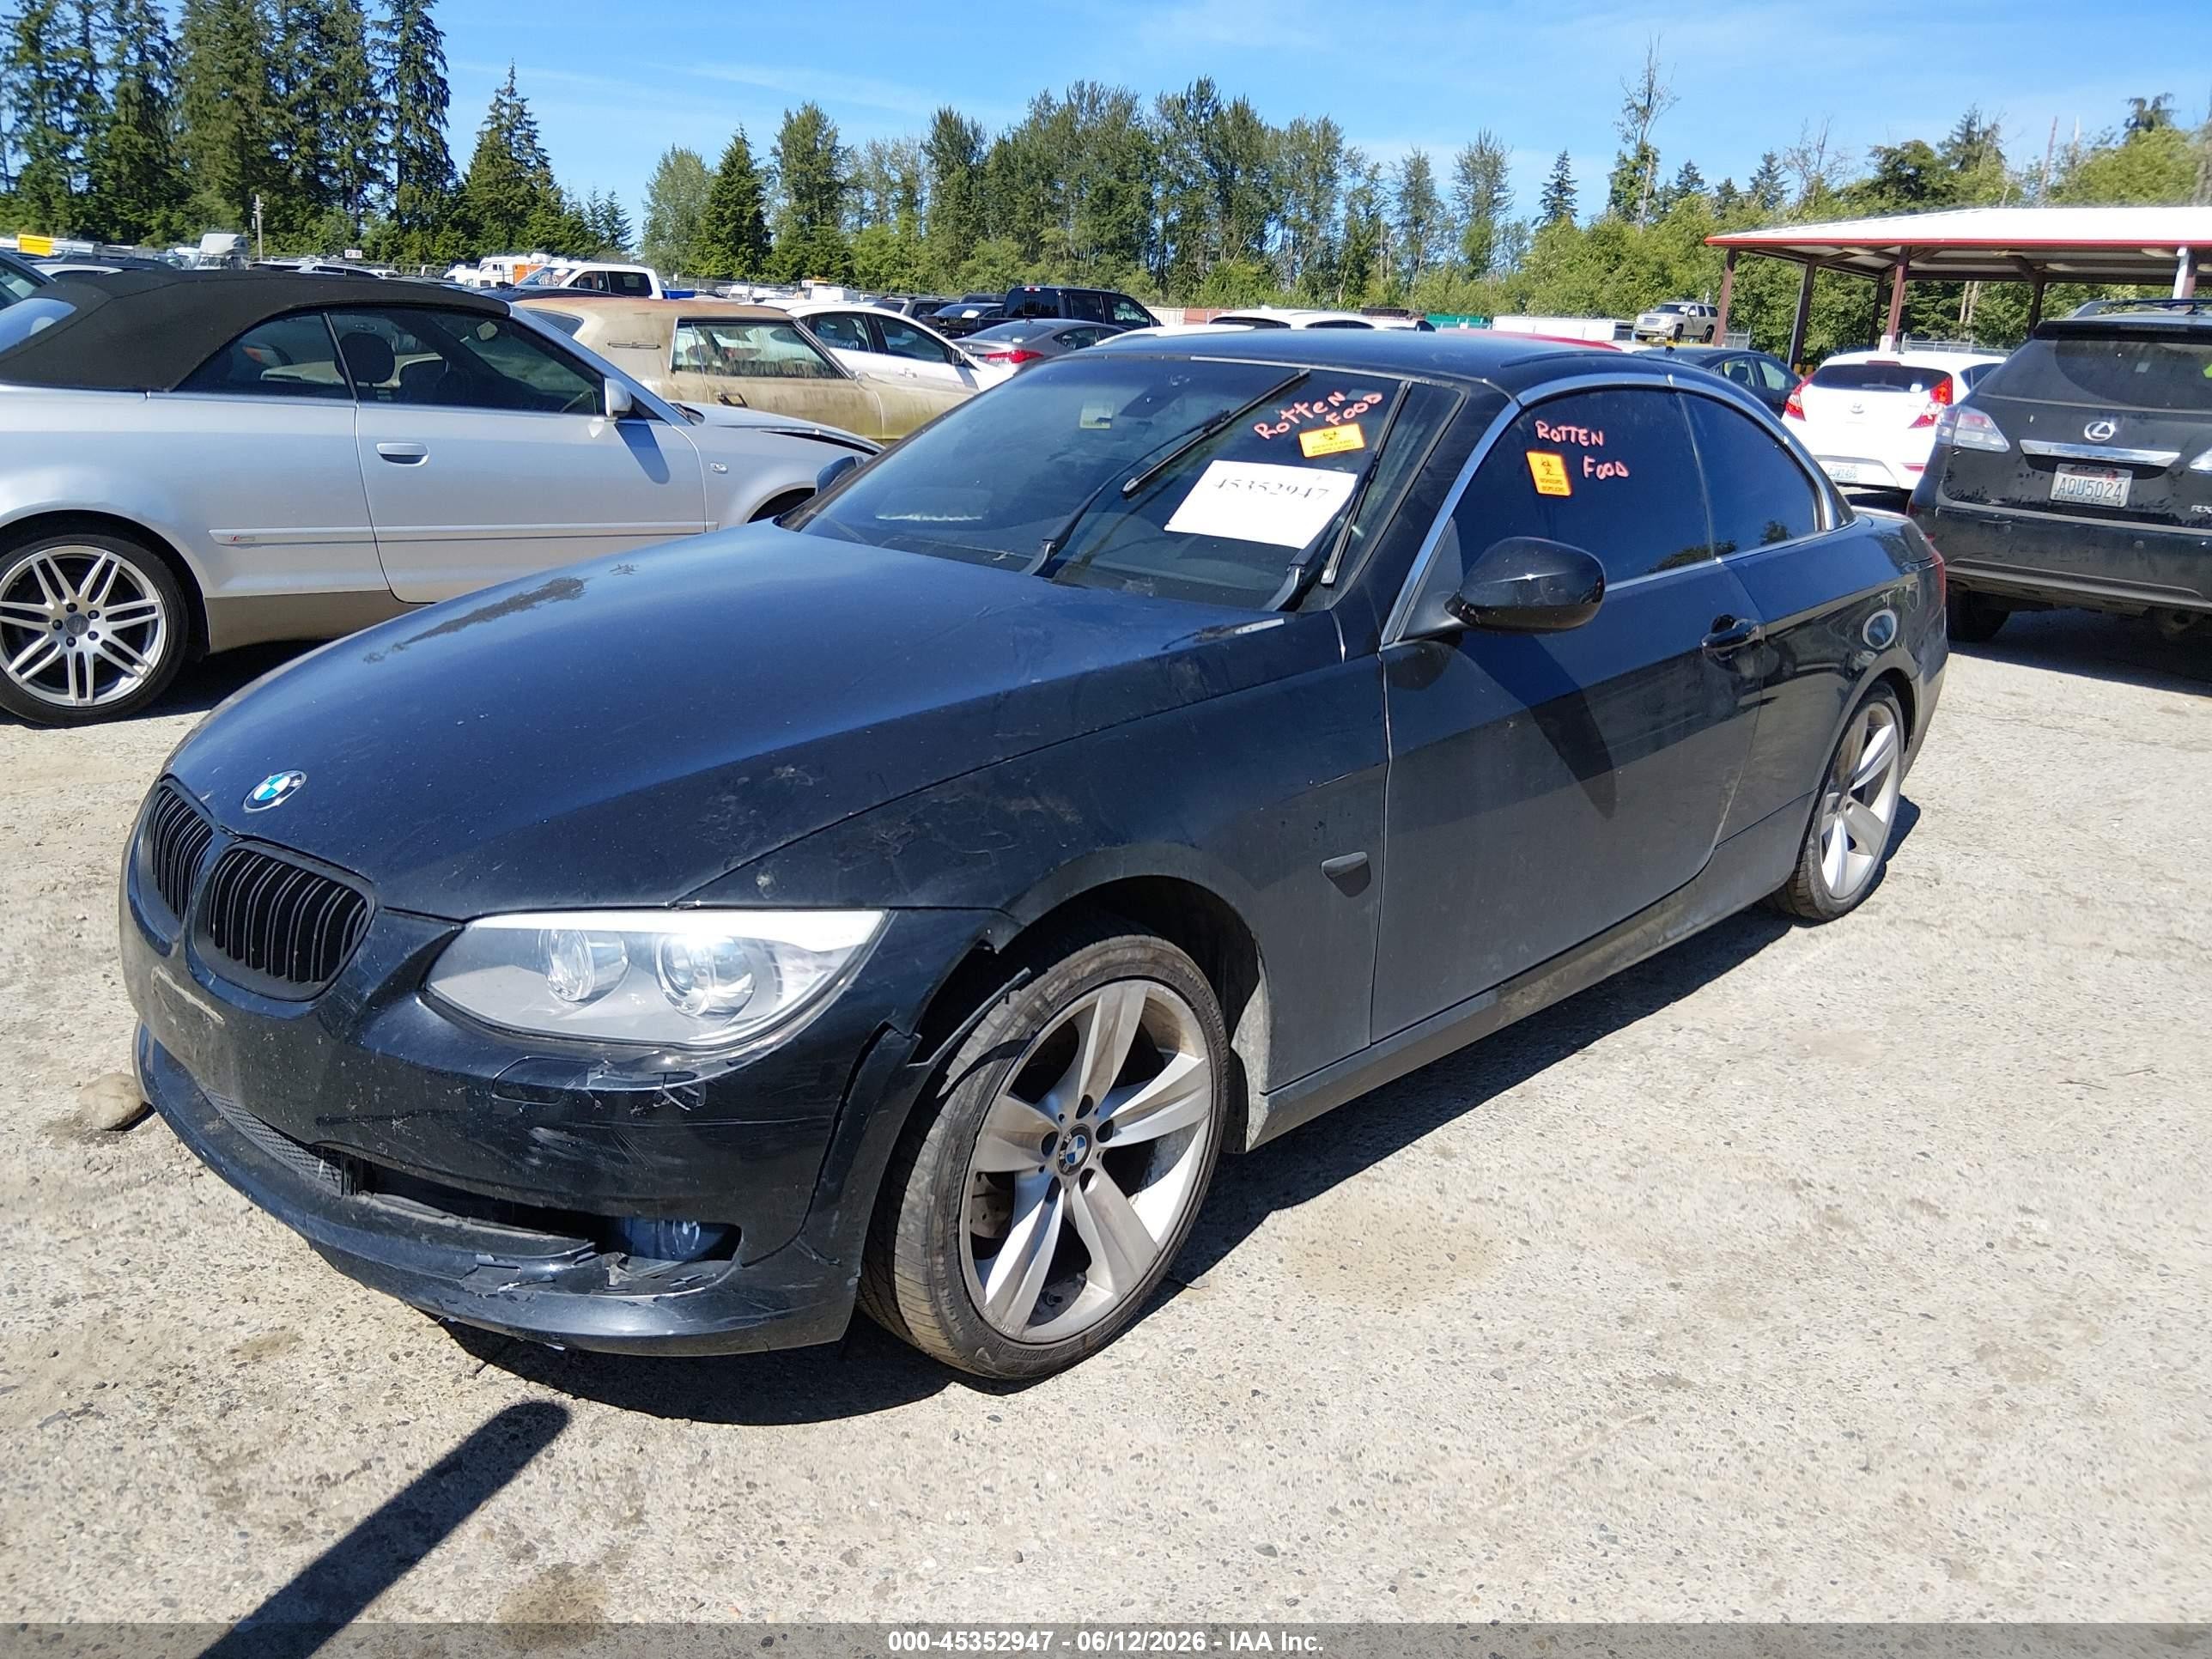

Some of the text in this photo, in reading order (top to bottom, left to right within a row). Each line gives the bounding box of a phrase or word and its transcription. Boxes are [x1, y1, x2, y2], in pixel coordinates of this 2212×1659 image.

[1534, 420, 1604, 447] ROTTEN
[1212, 477, 1330, 500] 45352947
[2057, 476, 2123, 501] AQU5024
